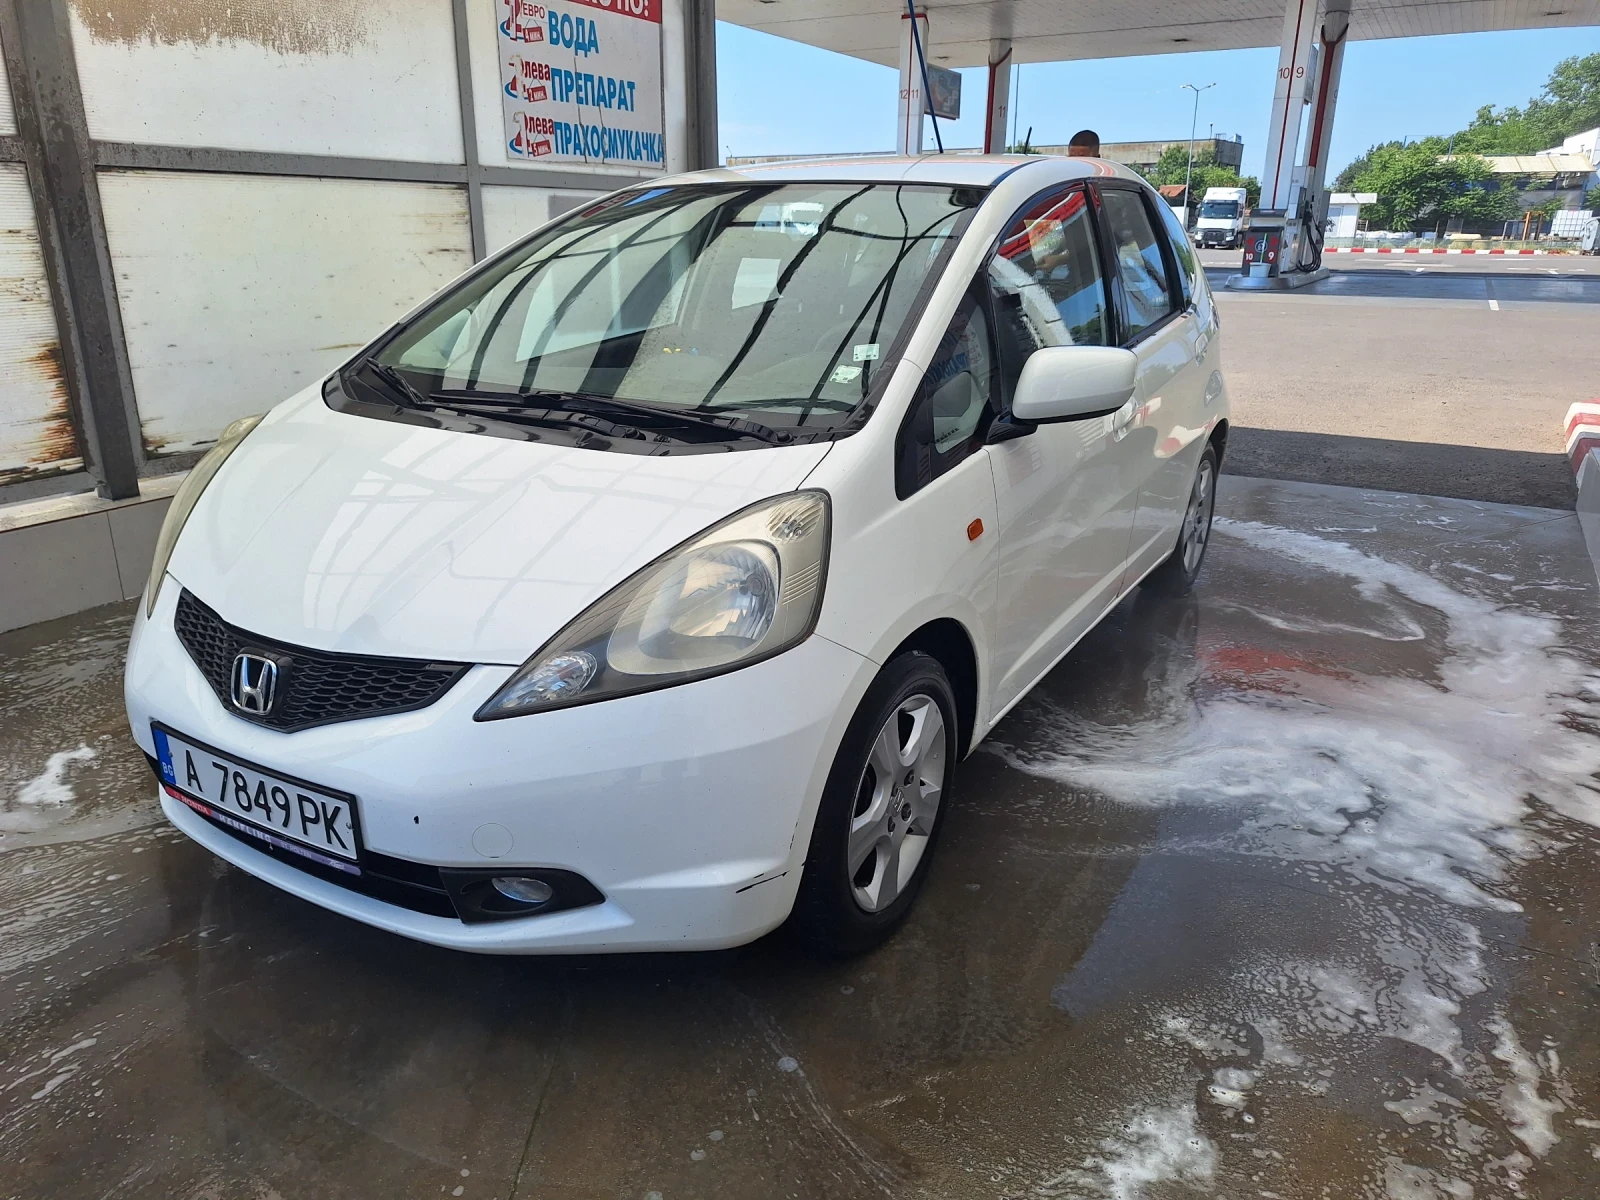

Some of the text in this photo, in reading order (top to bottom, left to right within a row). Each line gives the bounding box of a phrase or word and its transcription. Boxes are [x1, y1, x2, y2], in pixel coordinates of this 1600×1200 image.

[522, 2, 546, 19] ЕВРО
[548, 10, 599, 57] ВОДА
[524, 60, 551, 81] лева
[1278, 67, 1290, 79] 10
[1296, 66, 1304, 78] 9
[550, 67, 635, 112] ПРЕПАРАТ
[899, 89, 908, 99] 12
[911, 89, 919, 99] 11
[998, 105, 1006, 118] 11
[528, 116, 555, 135] лева
[553, 121, 664, 163] ПРАХОСМУКАЧКА
[1268, 251, 1275, 260] 9
[162, 761, 174, 777] BG
[181, 795, 209, 815] HONDA
[186, 749, 349, 850] A 7849 PK
